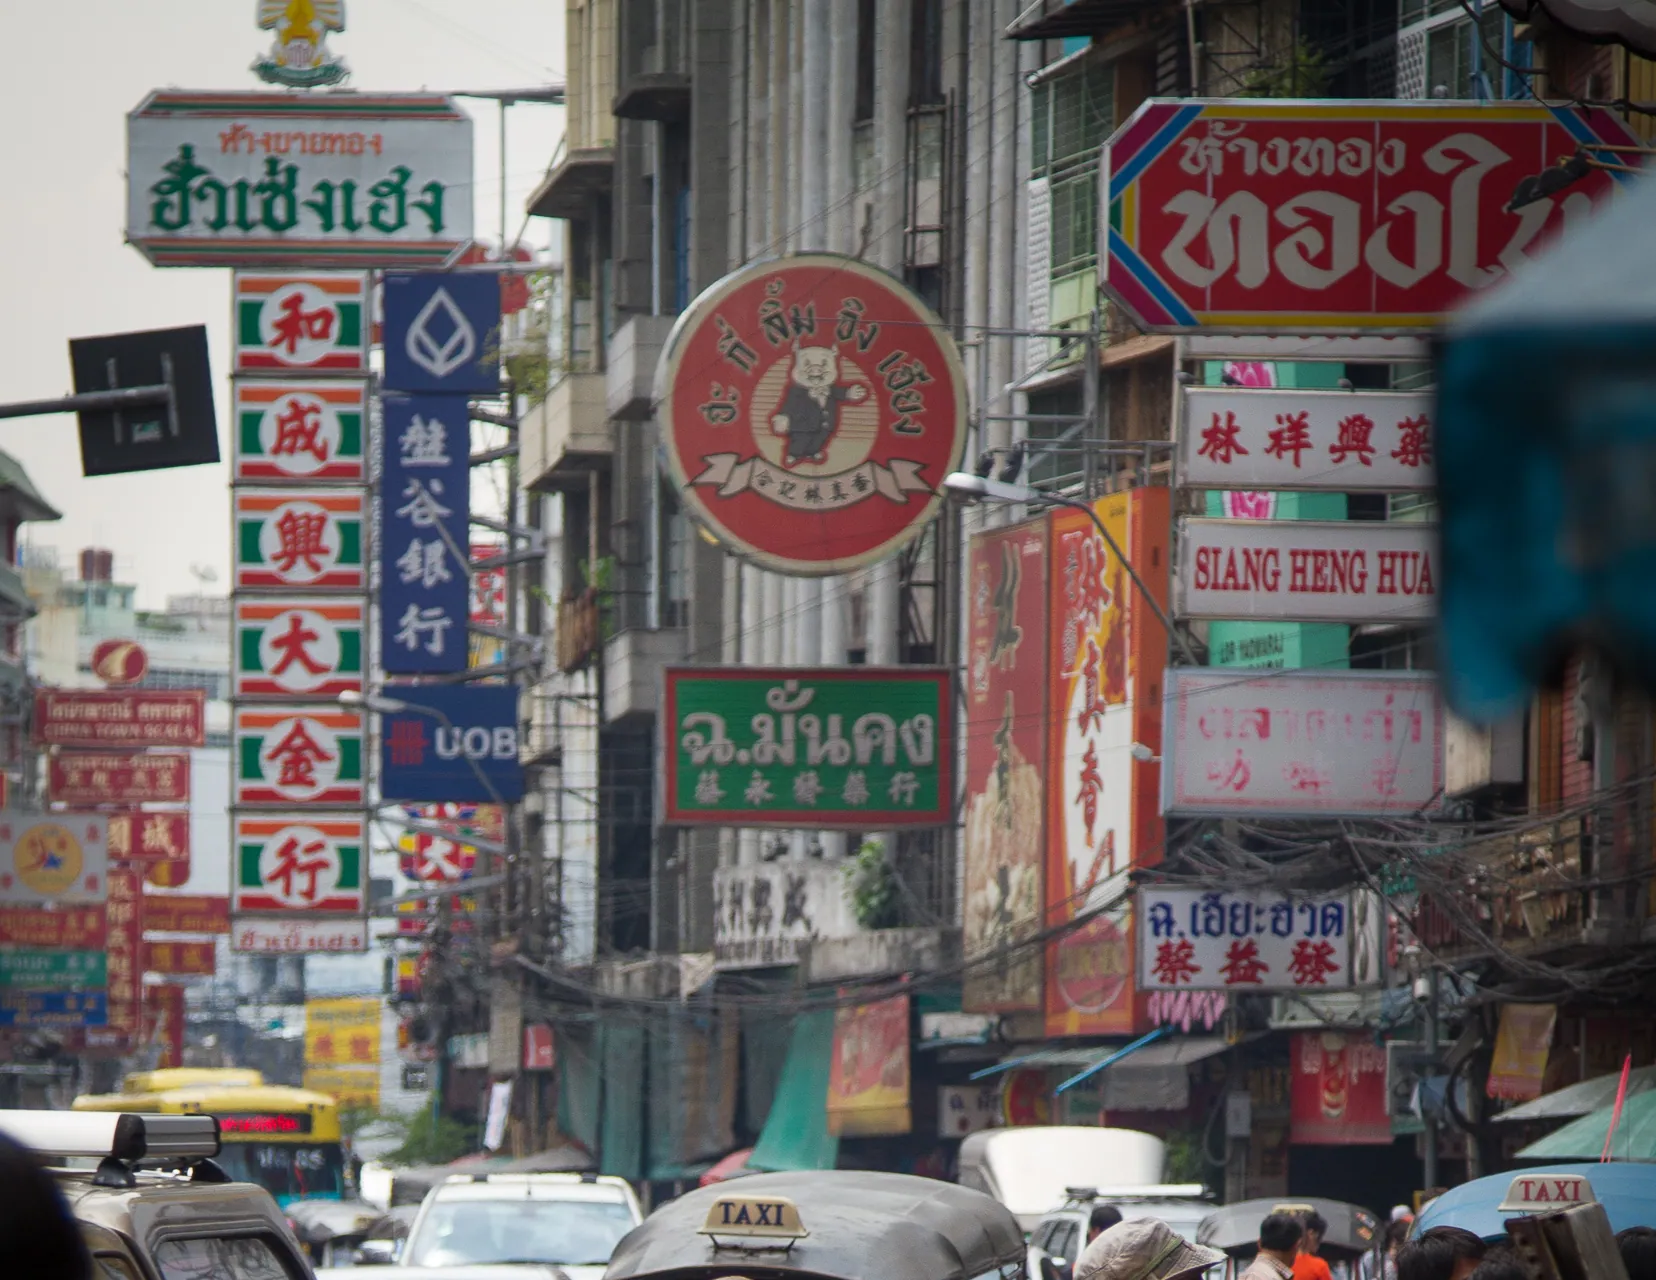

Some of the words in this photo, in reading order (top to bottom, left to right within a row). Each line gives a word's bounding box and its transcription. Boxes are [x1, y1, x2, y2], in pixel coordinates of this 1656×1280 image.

[1179, 120, 1405, 177] ห้างทอง
[1195, 546, 1281, 592] SIANG
[1288, 549, 1368, 594] HENG
[435, 726, 517, 761] UOB
[1518, 1180, 1583, 1202] TAXI
[718, 1202, 785, 1226] TAXI
